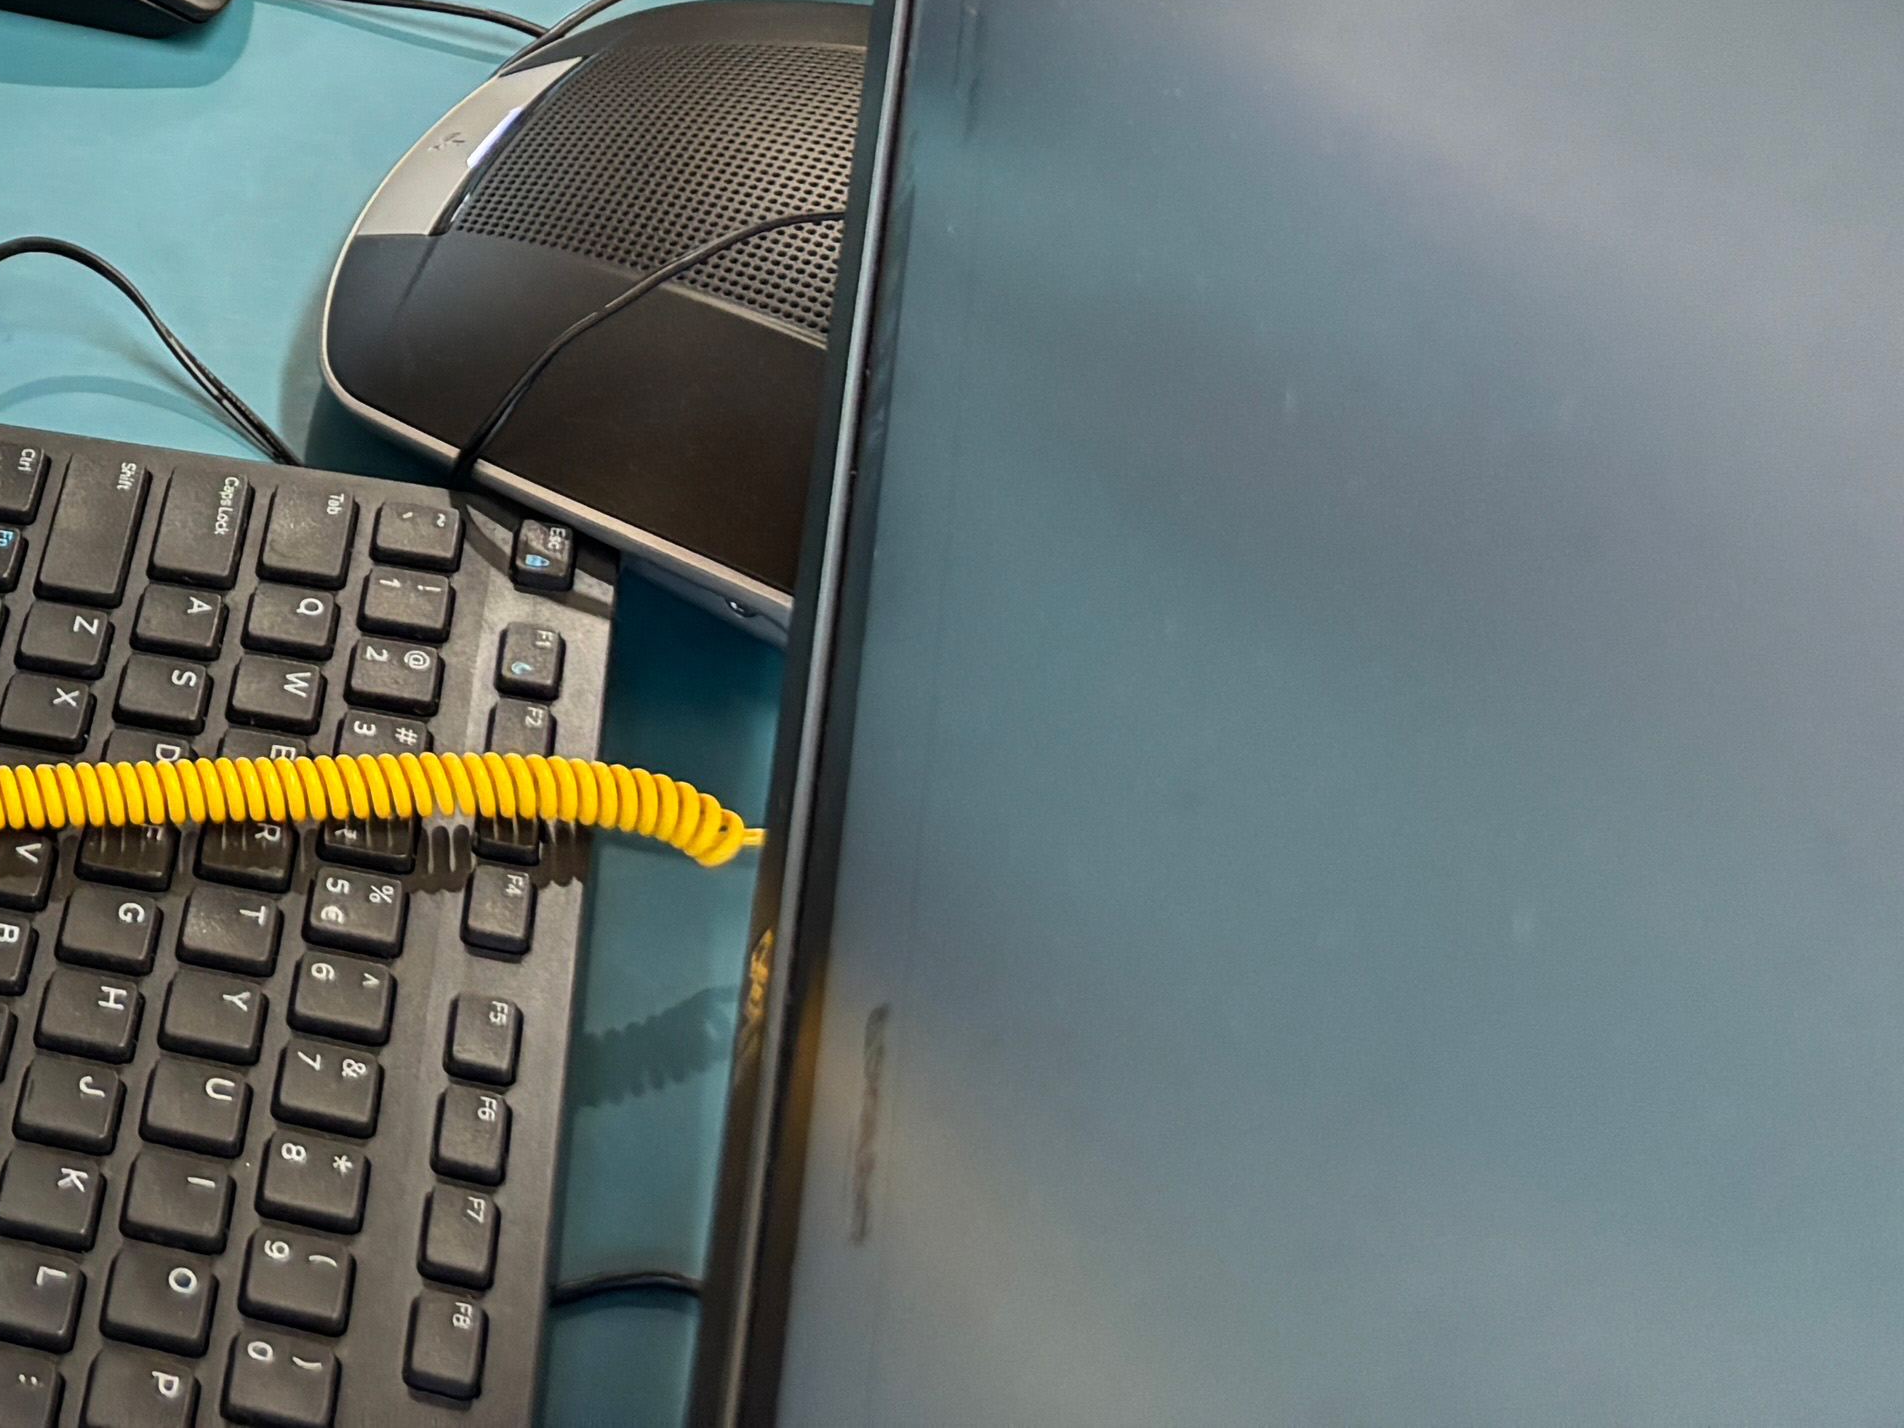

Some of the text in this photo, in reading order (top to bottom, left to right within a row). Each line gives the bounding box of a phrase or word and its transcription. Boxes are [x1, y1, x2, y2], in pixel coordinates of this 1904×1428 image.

[17, 447, 38, 474] Ctrl
[116, 461, 138, 492] Shift
[326, 493, 346, 517] Tab
[548, 526, 566, 552] Esc
[378, 578, 401, 588] 1
[187, 596, 214, 616] A
[295, 597, 326, 617] Q
[72, 616, 99, 635] Z
[534, 631, 551, 649] F1
[365, 646, 390, 663] 2
[403, 650, 431, 671] @
[171, 669, 197, 688] S
[283, 672, 312, 698] W
[52, 687, 81, 709] X
[524, 707, 545, 728] F2
[354, 721, 377, 738] 3
[394, 728, 419, 746] #
[156, 744, 184, 765] D
[256, 823, 280, 842] R
[15, 843, 42, 865] V
[325, 877, 351, 895] 5
[368, 883, 394, 905] %
[505, 872, 527, 898] F4
[117, 901, 146, 923] G
[239, 905, 268, 926] T
[318, 903, 345, 925] €
[310, 962, 336, 982] 6
[97, 984, 129, 1009] H
[221, 990, 250, 1012] Y
[488, 1000, 510, 1025] F5
[297, 1053, 322, 1071] 7
[340, 1058, 370, 1079] &
[78, 1075, 107, 1097] J
[204, 1079, 235, 1102] U
[477, 1097, 499, 1123] F6
[281, 1143, 307, 1162] 8
[55, 1166, 89, 1194] K
[467, 1195, 486, 1224] F7
[263, 1239, 291, 1261] 9
[36, 1267, 67, 1286] L
[167, 1266, 198, 1294] O
[451, 1302, 474, 1328] F8
[246, 1340, 274, 1360] 0
[151, 1369, 182, 1399] P
